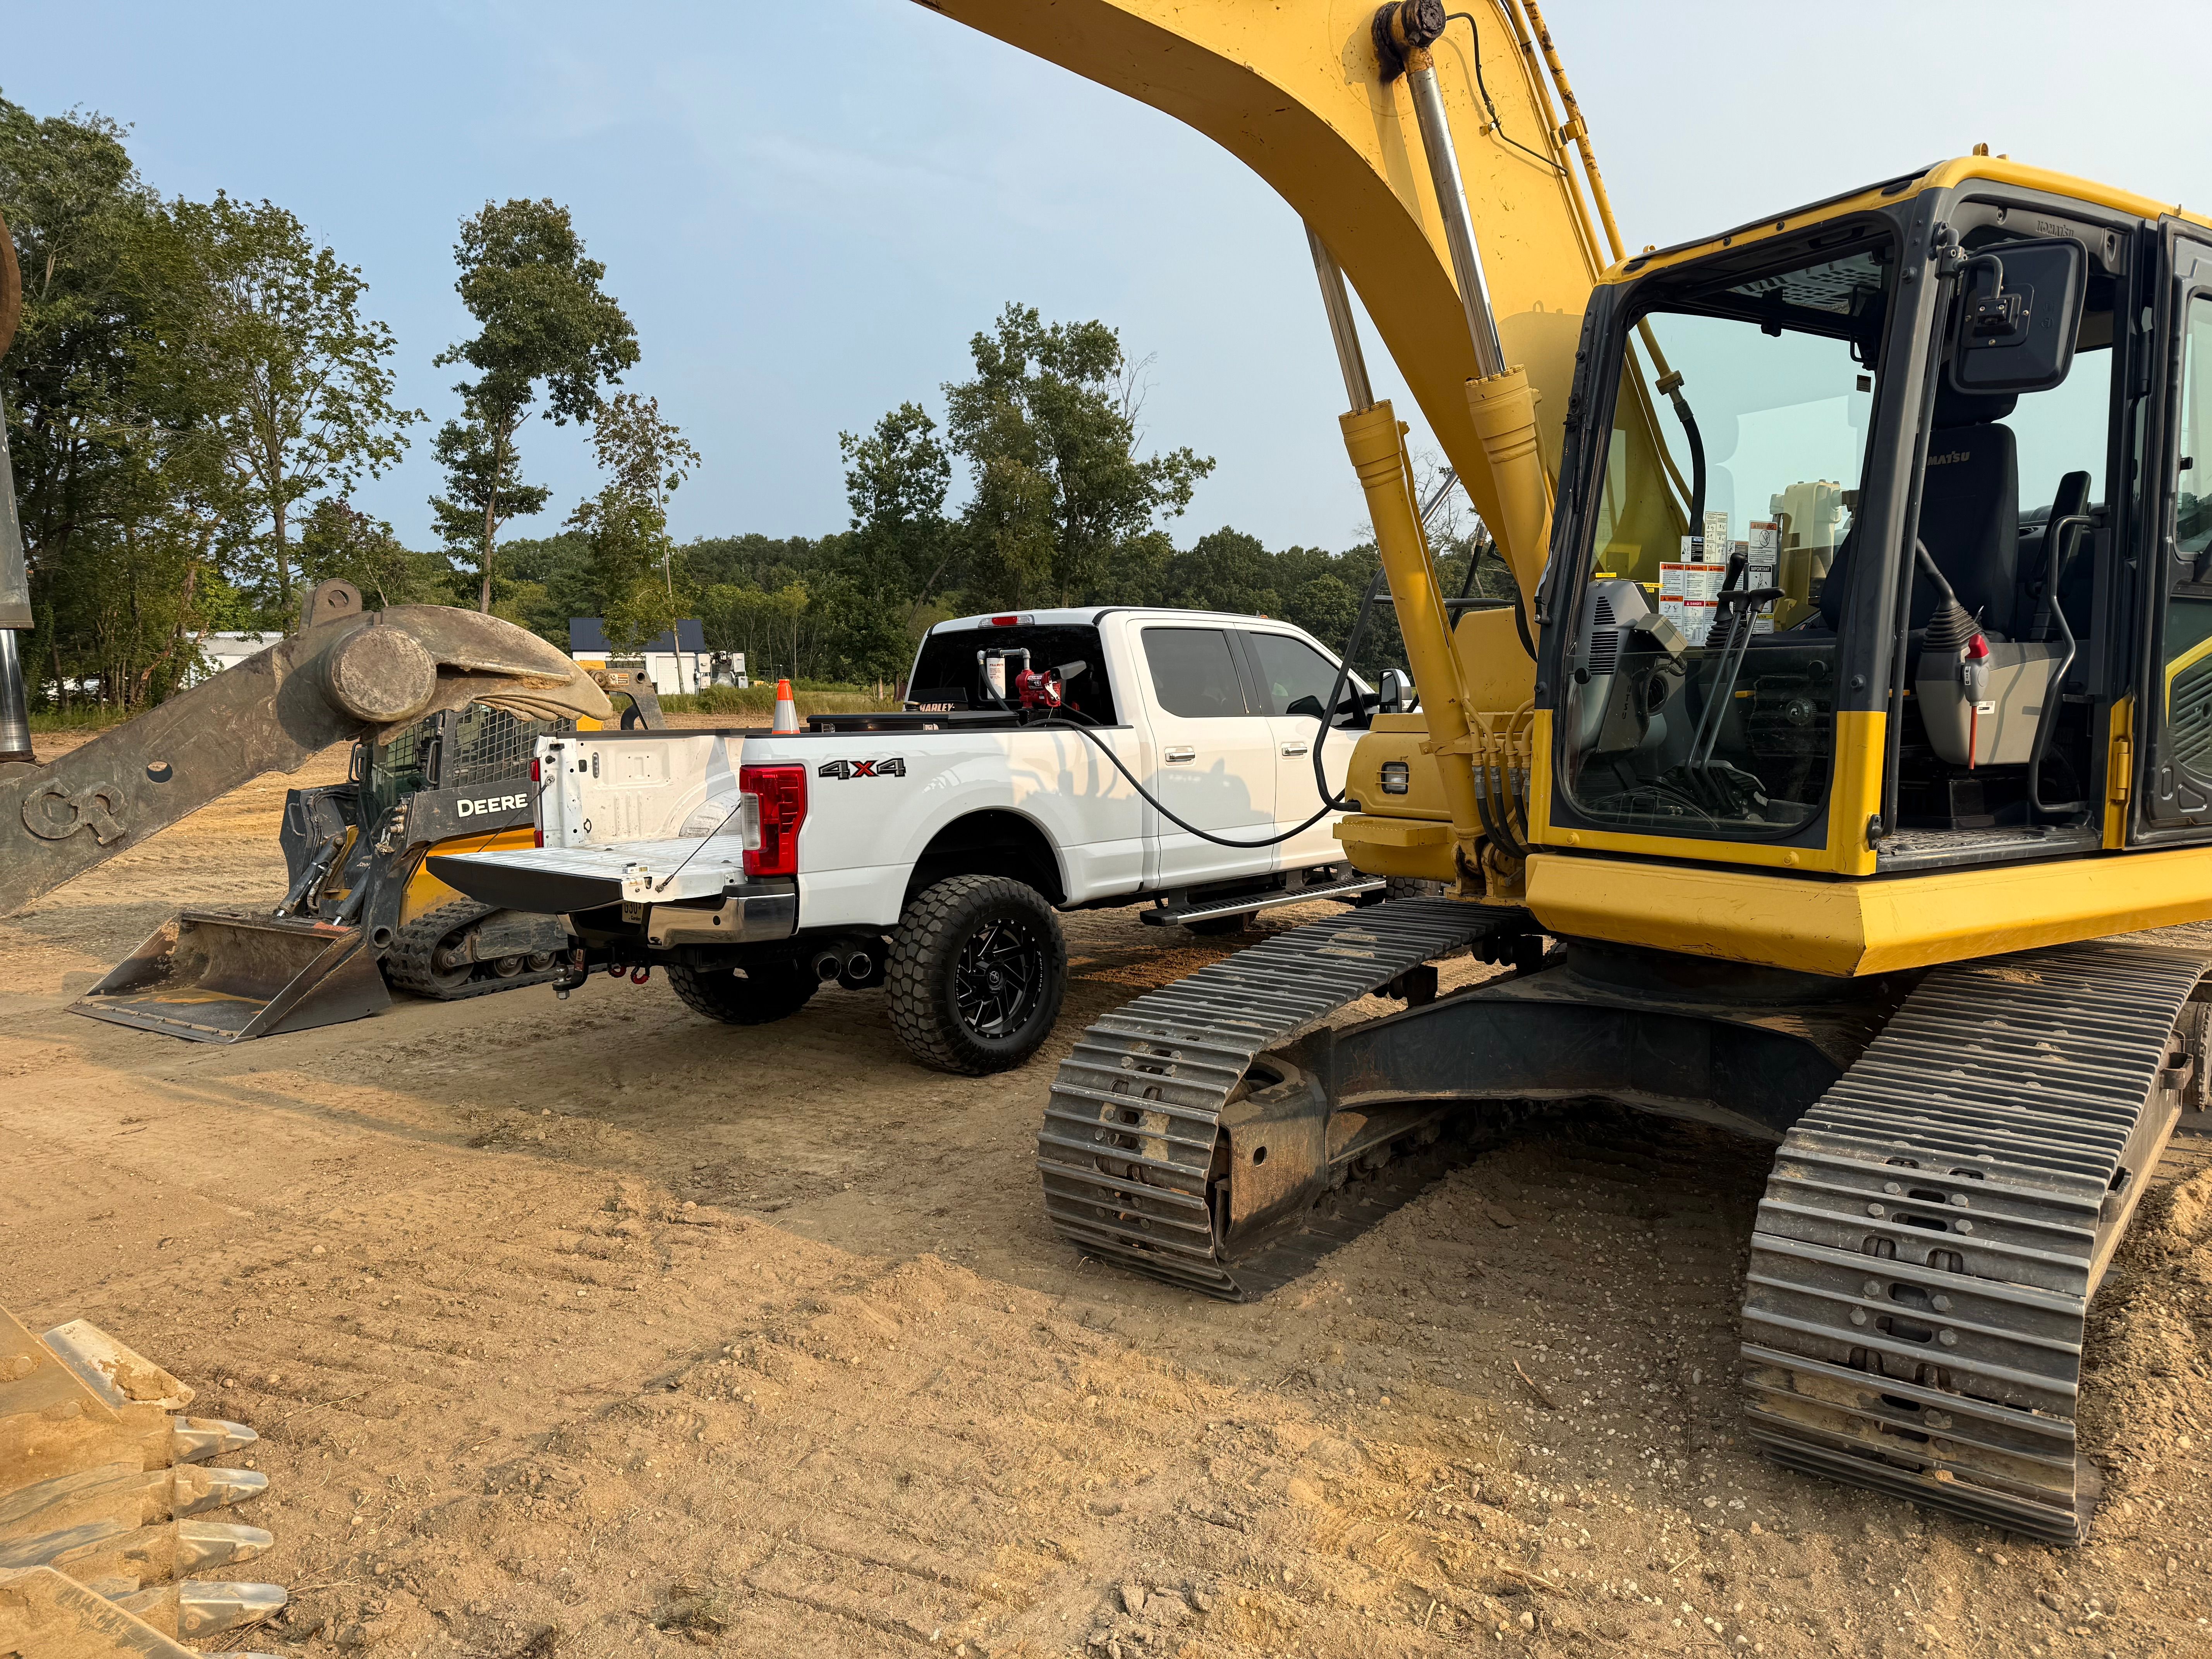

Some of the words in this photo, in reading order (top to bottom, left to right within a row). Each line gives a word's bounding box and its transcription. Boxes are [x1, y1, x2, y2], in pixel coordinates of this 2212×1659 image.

[2037, 220, 2074, 237] KOMATSU
[1927, 450, 1970, 466] MATSU
[919, 703, 955, 712] HARLEY-
[457, 793, 528, 817] DEERE
[953, 1023, 1010, 1054] IRONMAN
